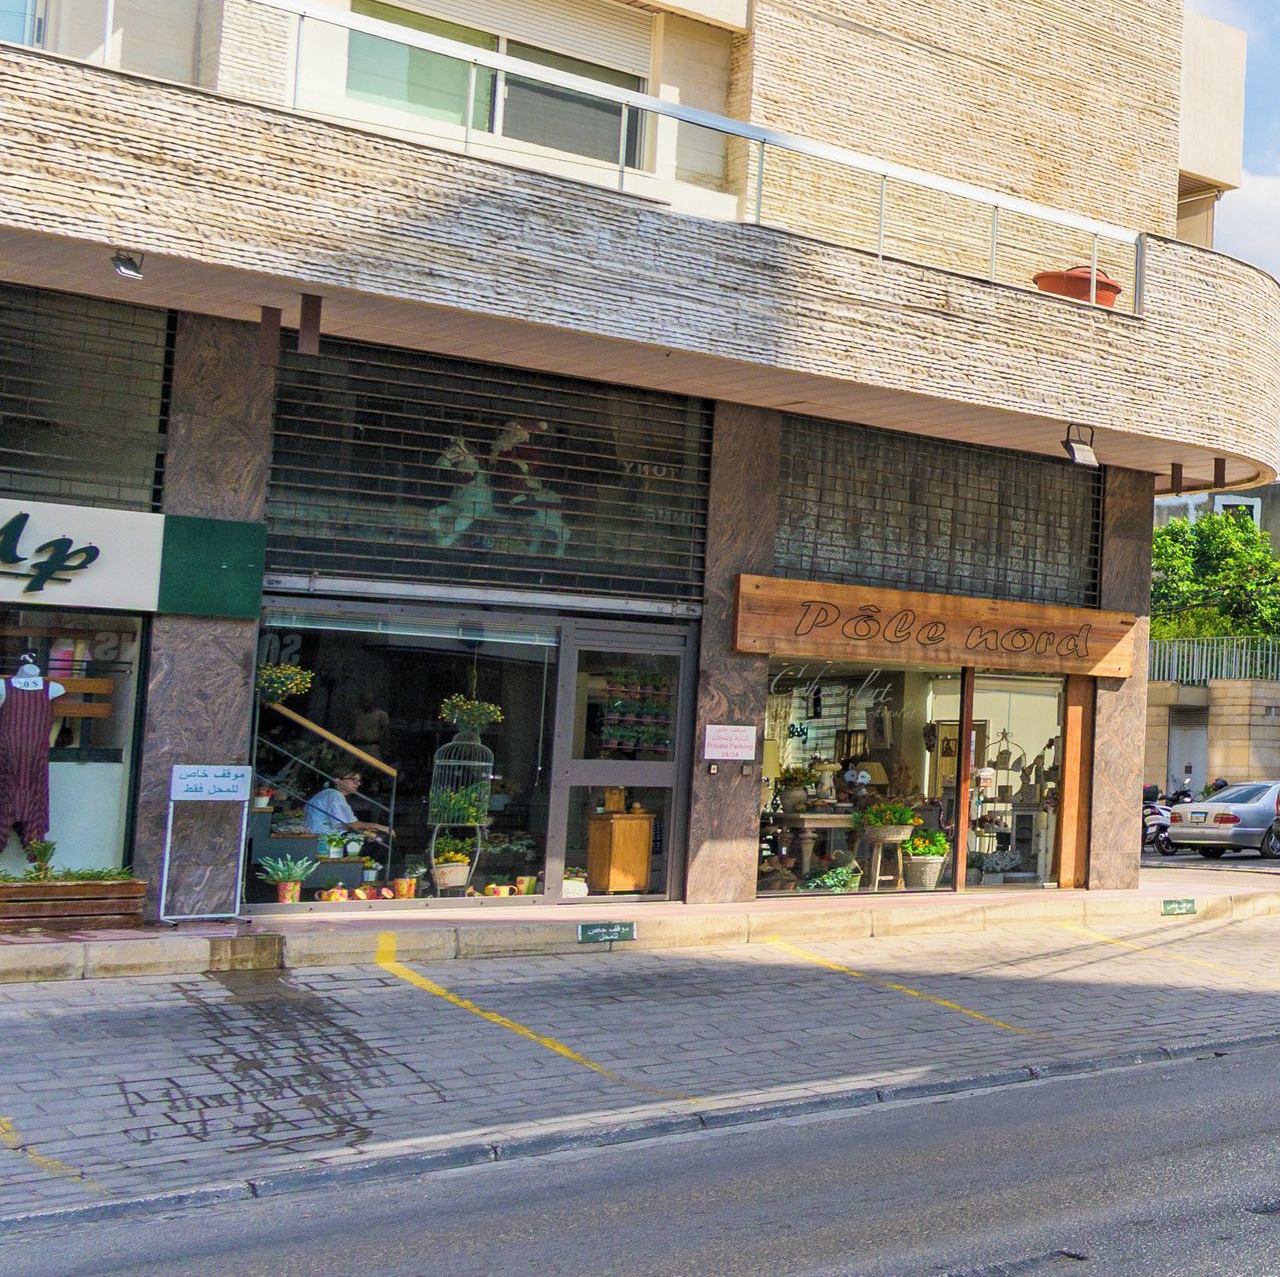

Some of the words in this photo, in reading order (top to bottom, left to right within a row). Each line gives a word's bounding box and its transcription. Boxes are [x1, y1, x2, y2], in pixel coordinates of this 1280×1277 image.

[795, 600, 946, 645] Pôle
[965, 624, 1092, 658] nord
[179, 769, 209, 780] خاص
[214, 768, 245, 780] موقف
[183, 783, 204, 793] فقط
[208, 784, 239, 795] للمحل
[609, 924, 630, 934] موقف
